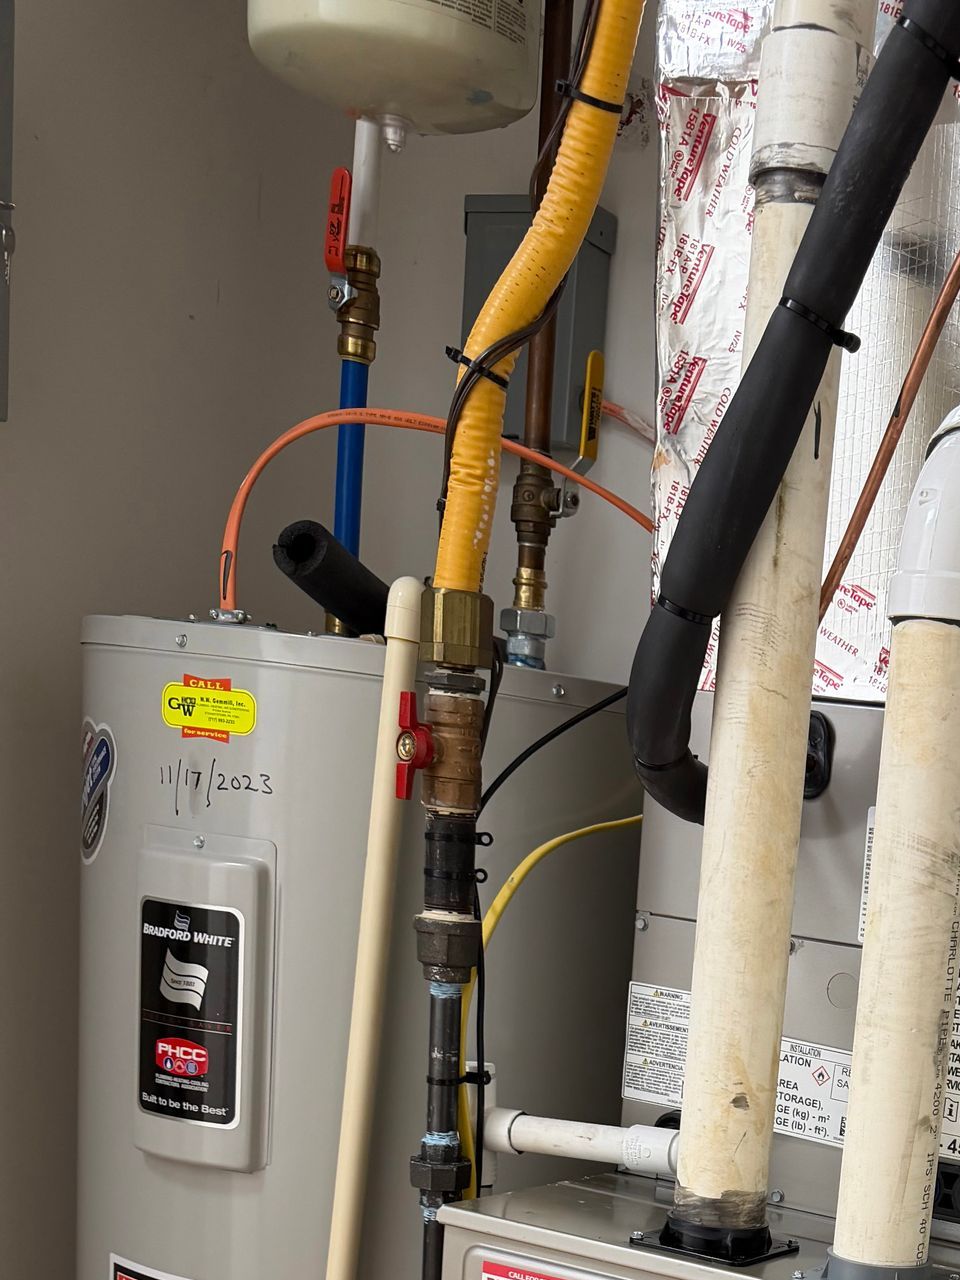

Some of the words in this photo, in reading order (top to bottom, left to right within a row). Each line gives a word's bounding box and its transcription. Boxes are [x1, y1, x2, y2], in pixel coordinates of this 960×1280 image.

[679, 108, 699, 146] 1581A
[674, 113, 713, 201] VentureTape
[706, 164, 732, 218] WEATHER
[665, 233, 690, 275] 181B-FX
[681, 239, 700, 274] 181A-P
[670, 244, 711, 324] VentureTape
[668, 350, 689, 384] 1581A
[663, 356, 702, 435] VentureTape
[663, 480, 680, 521] 181B-FX
[820, 626, 859, 656] WEATHER
[189, 679, 224, 690] CALL
[197, 730, 227, 738] service
[160, 758, 273, 816] 11/17/2023
[143, 922, 191, 942] BRADFORD
[193, 931, 232, 947] WHITE
[944, 921, 960, 1002] CHARLOTTE
[158, 1042, 207, 1062] PHCC
[649, 1060, 683, 1071] ADVERTENCIA
[790, 1044, 821, 1057] INSTALLATION
[142, 1092, 157, 1104] Built
[159, 1096, 167, 1106] to
[169, 1097, 181, 1109] be
[182, 1100, 199, 1112] the
[201, 1103, 227, 1116] Best
[792, 1108, 810, 1120] (kg)
[932, 1082, 942, 1116] 4200
[792, 1120, 806, 1132] (lb)
[926, 1152, 934, 1176] IPS
[921, 1184, 931, 1210] SCH
[508, 1271, 525, 1280] CALL
